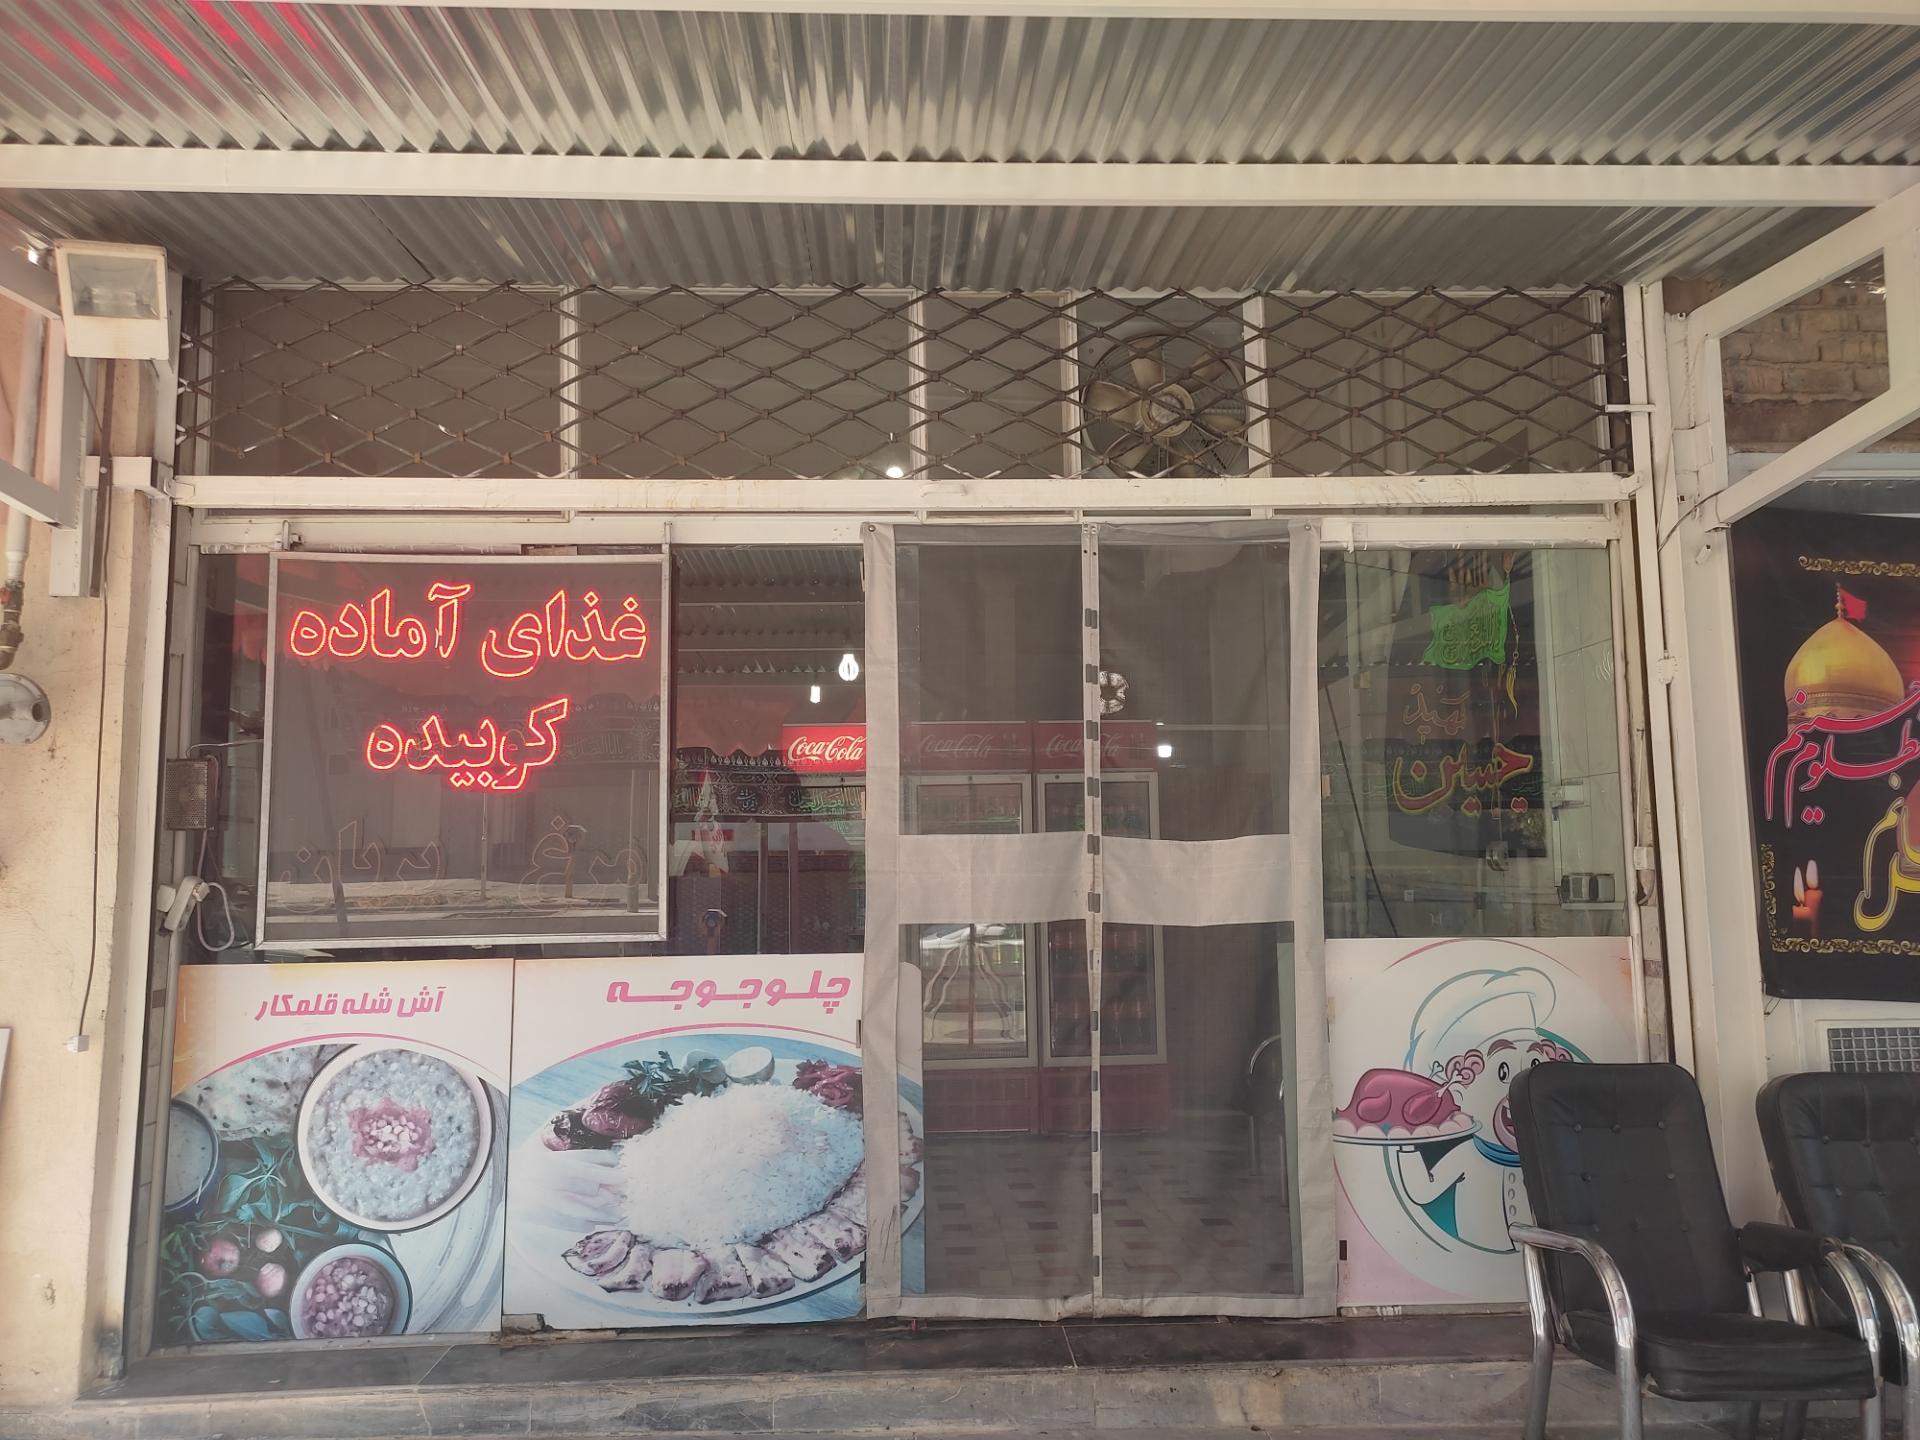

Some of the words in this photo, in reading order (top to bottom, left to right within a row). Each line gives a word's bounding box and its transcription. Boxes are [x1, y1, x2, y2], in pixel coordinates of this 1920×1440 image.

[290, 583, 471, 659] آماده
[481, 590, 647, 677] غذای
[366, 697, 569, 790] کوبیده
[787, 735, 867, 762] Coca-Cola
[254, 993, 339, 1022] قلمکار
[342, 987, 393, 1015] شله
[397, 985, 447, 1018] آش
